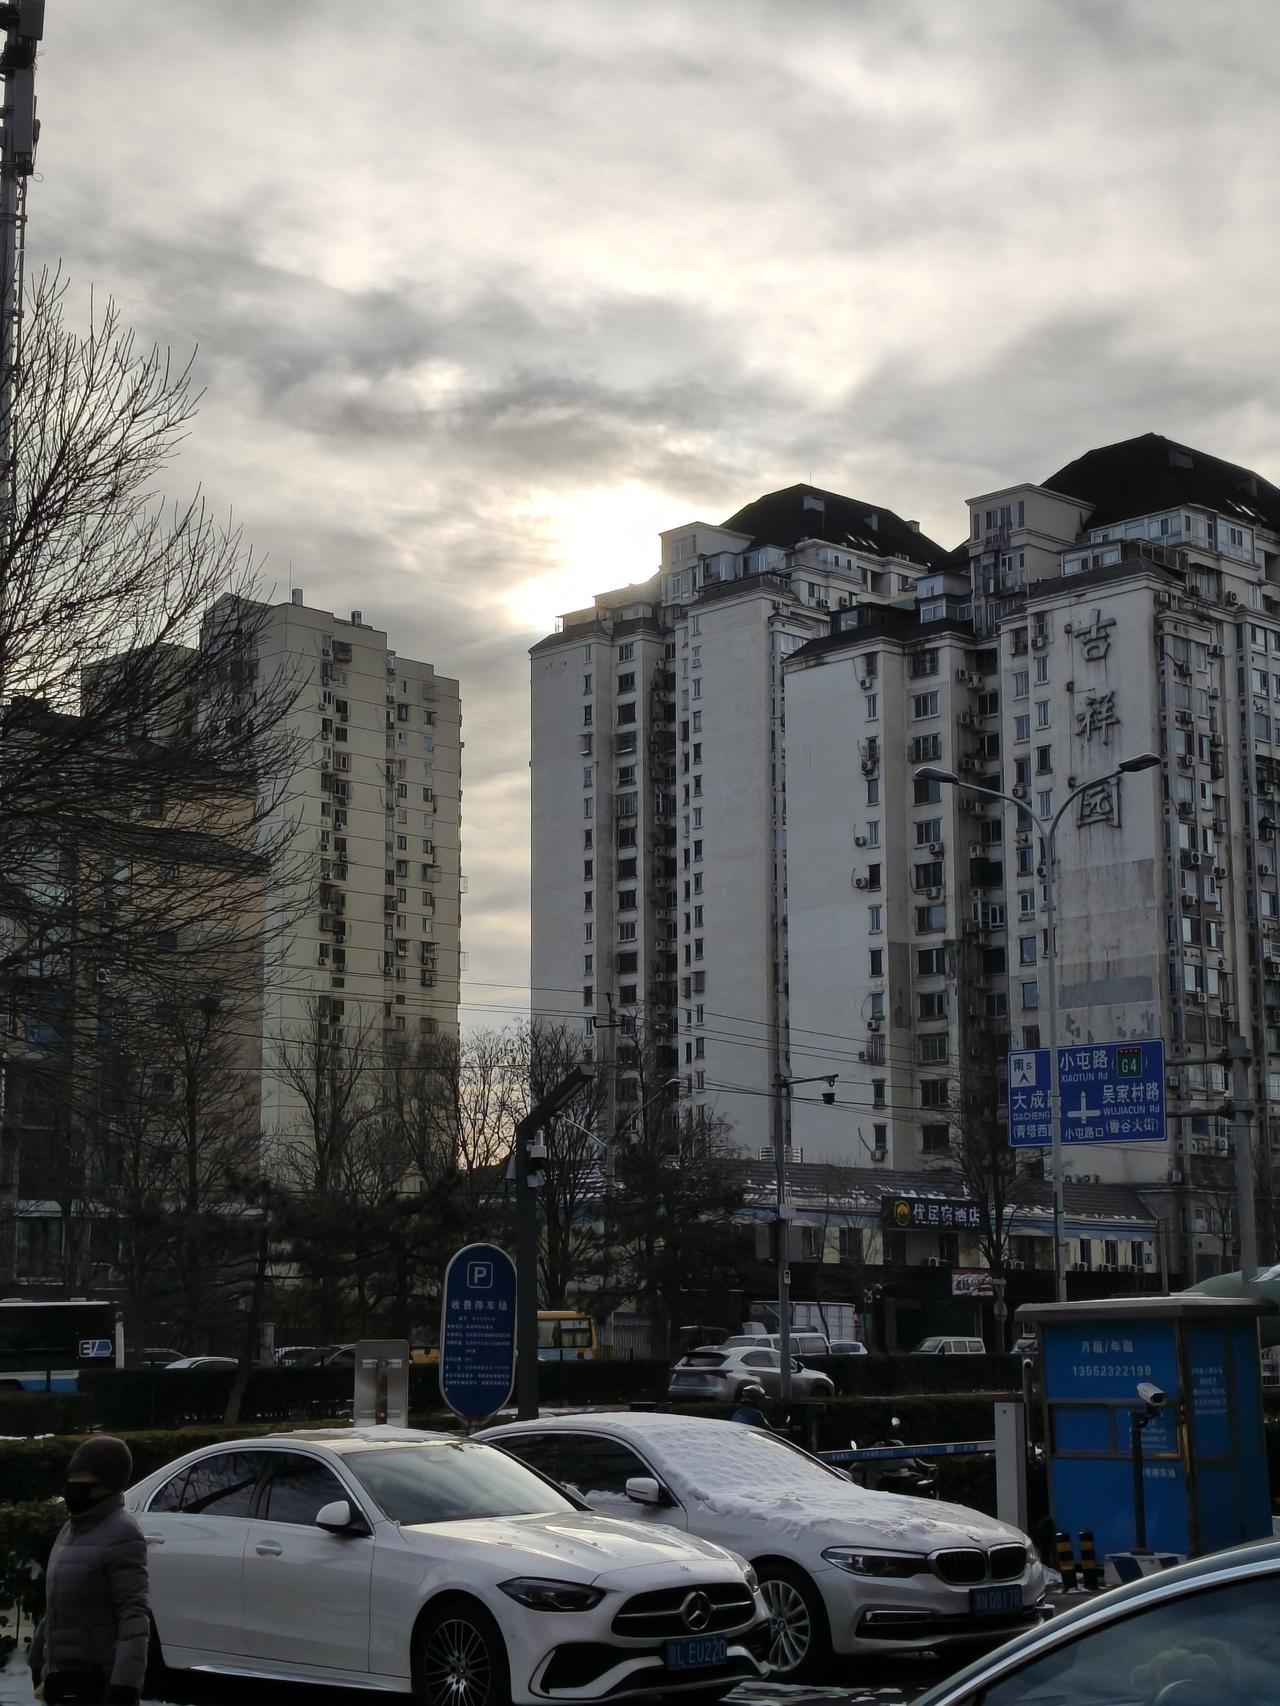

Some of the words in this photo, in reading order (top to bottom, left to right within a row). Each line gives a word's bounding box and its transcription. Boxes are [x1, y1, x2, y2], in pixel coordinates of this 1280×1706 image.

[1074, 608, 1122, 829] 吉祥园
[1013, 1058, 1024, 1072] 南
[1026, 1062, 1032, 1070] S
[1060, 1048, 1109, 1071] 小屯路
[1121, 1058, 1137, 1073] G4
[1060, 1072, 1095, 1083] XIAOTUN
[1098, 1071, 1108, 1081] Rd
[1102, 1082, 1160, 1104] 吴家村路
[1103, 1105, 1146, 1116] WUJIACUN
[1149, 1104, 1160, 1114] Rd
